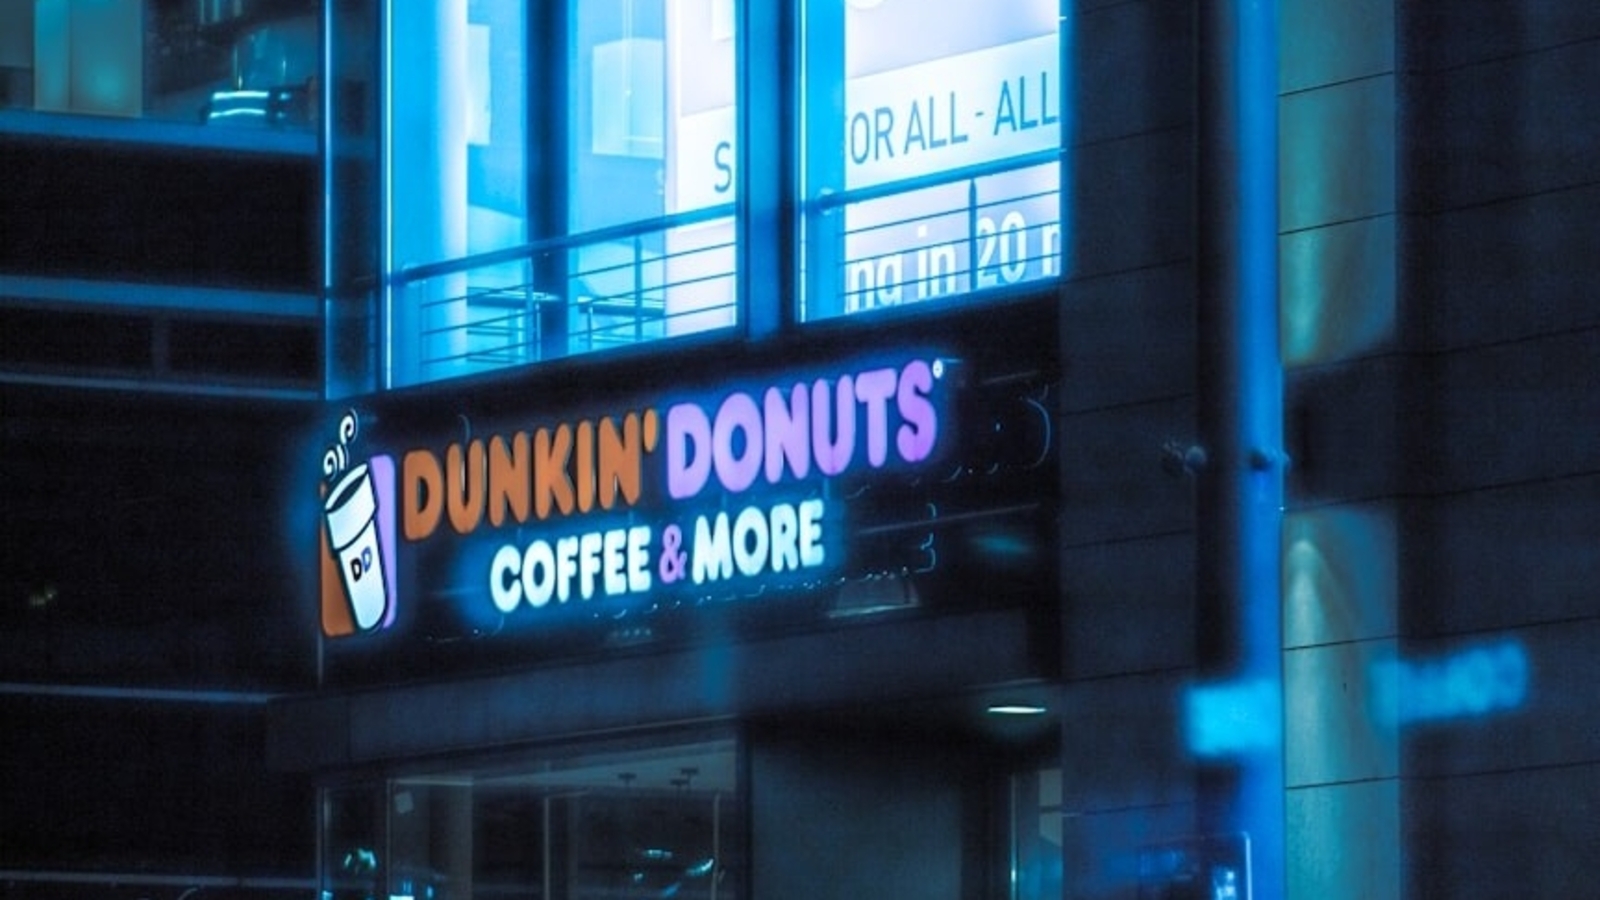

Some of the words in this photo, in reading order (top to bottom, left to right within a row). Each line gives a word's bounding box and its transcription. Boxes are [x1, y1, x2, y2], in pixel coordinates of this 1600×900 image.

[903, 91, 968, 155] ALL
[993, 71, 1059, 136] ALL
[918, 225, 956, 301] in
[976, 211, 1026, 288] 20
[403, 408, 657, 541] DUNKIN'
[667, 359, 937, 499] DONUTS
[350, 546, 373, 582] DD
[490, 526, 651, 613] COFFEE
[659, 524, 688, 584] &
[692, 499, 825, 585] MORE
